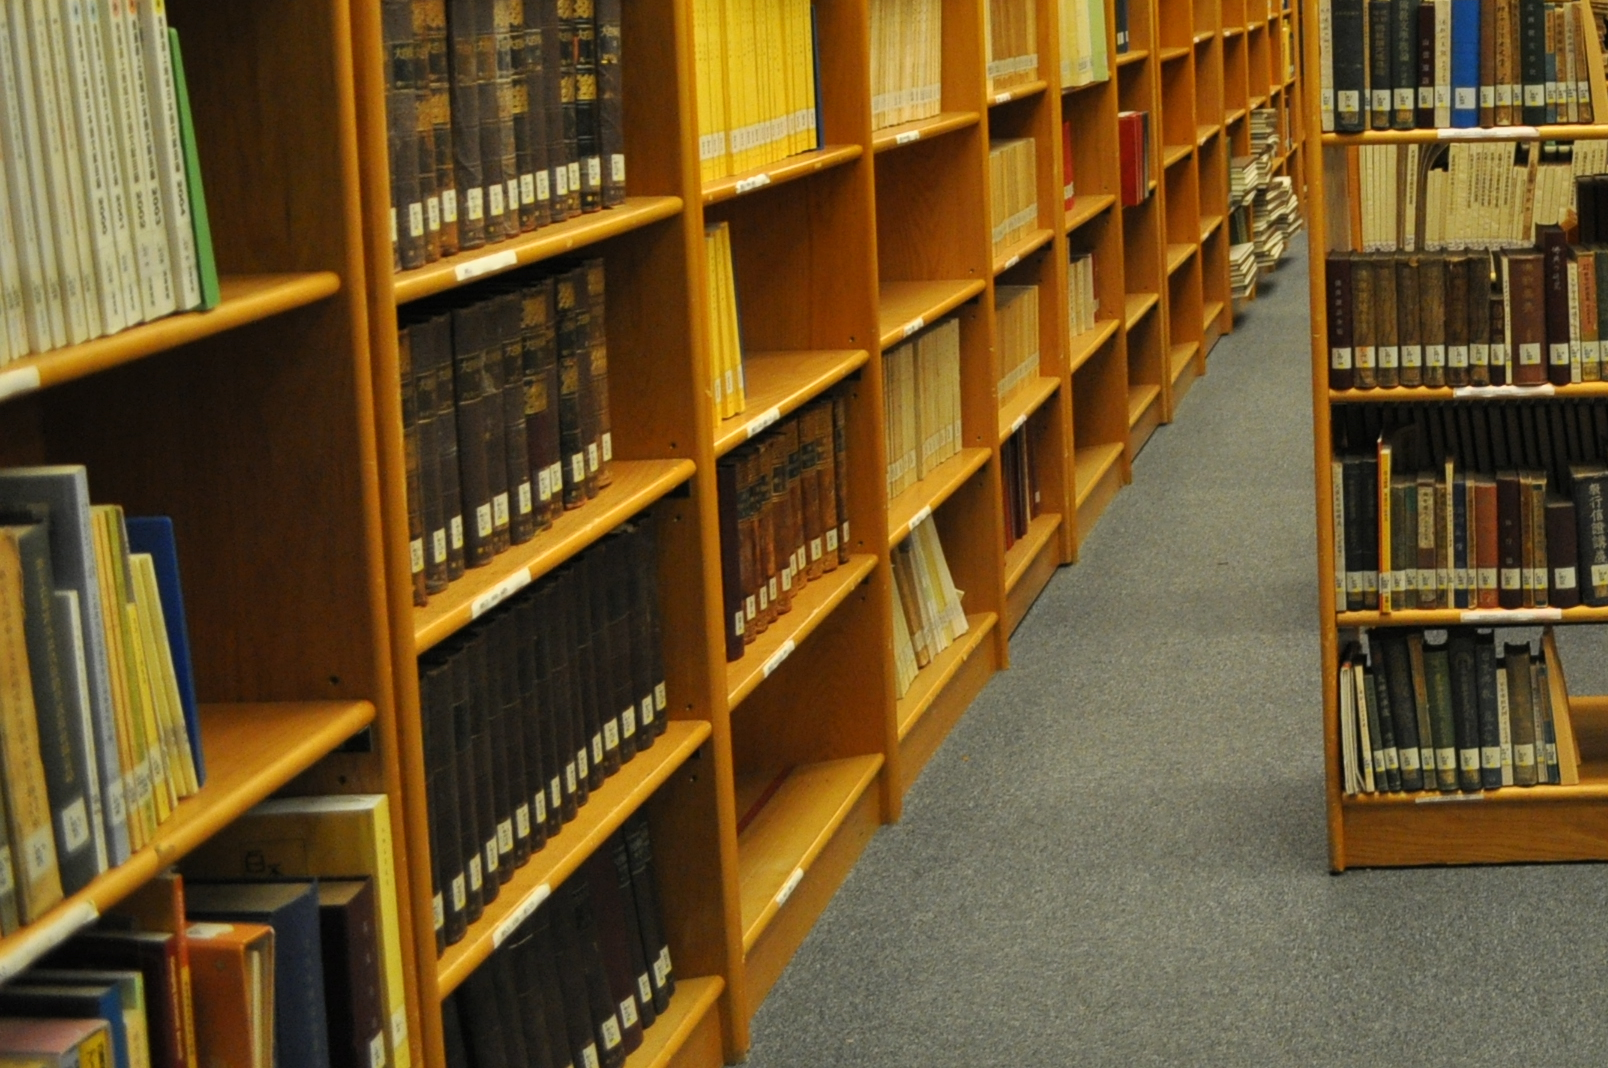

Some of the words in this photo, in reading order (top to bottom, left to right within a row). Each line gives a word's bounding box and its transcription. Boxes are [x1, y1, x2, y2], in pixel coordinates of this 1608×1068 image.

[98, 197, 107, 235] 2000
[115, 193, 125, 230] 2001
[135, 191, 145, 229] 2002
[151, 186, 161, 226] 2003
[176, 179, 186, 217] 2004
